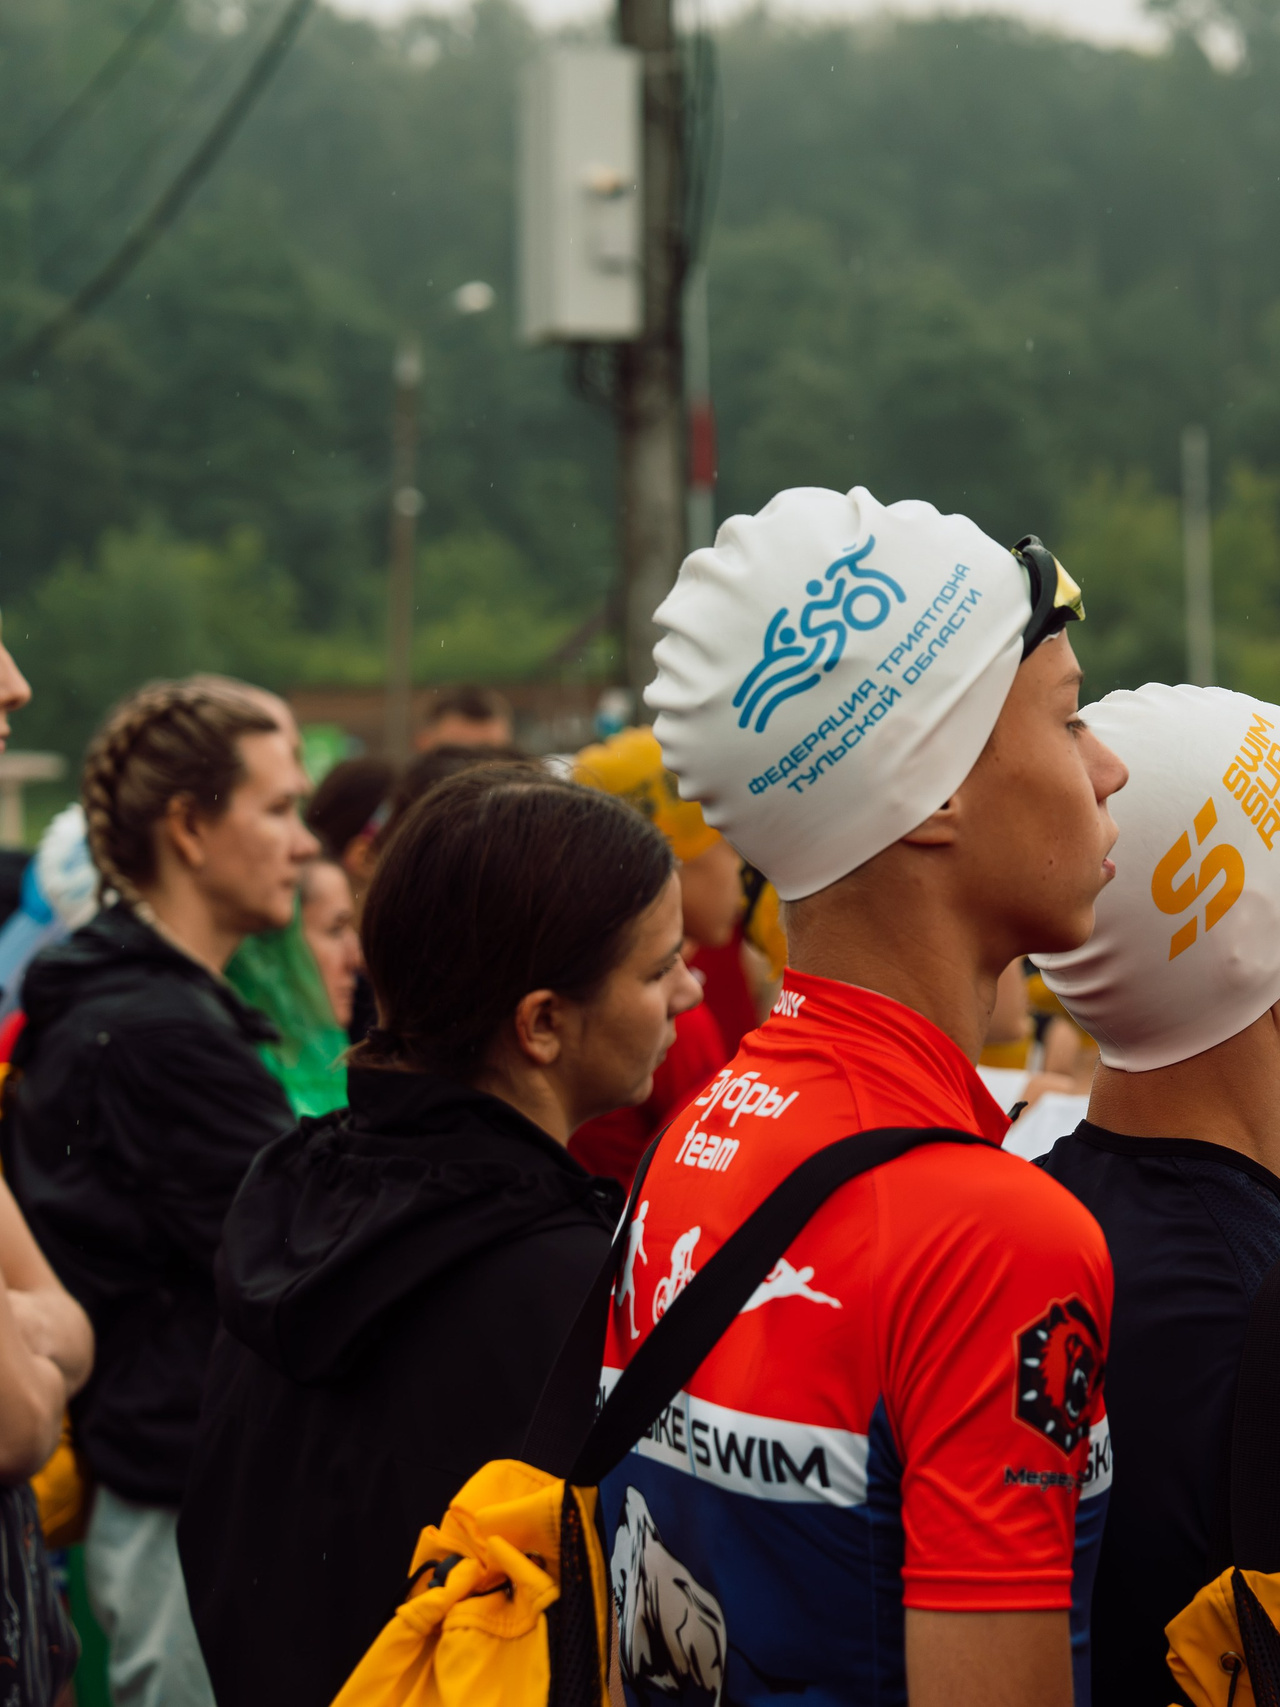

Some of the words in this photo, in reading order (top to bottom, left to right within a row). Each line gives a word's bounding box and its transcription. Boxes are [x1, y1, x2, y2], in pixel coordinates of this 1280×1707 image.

[747, 678, 878, 796] ФЕДЕРАЦИЯ
[875, 562, 971, 675] ТРИАТЛОНА
[786, 684, 903, 794] ТУЛЬСКОЙ
[901, 587, 983, 686] ОБЛАСТИ
[1222, 712, 1275, 801] SWIM
[694, 1069, 800, 1128] Зубры
[675, 1120, 740, 1172] team
[692, 1418, 830, 1488] SWIM
